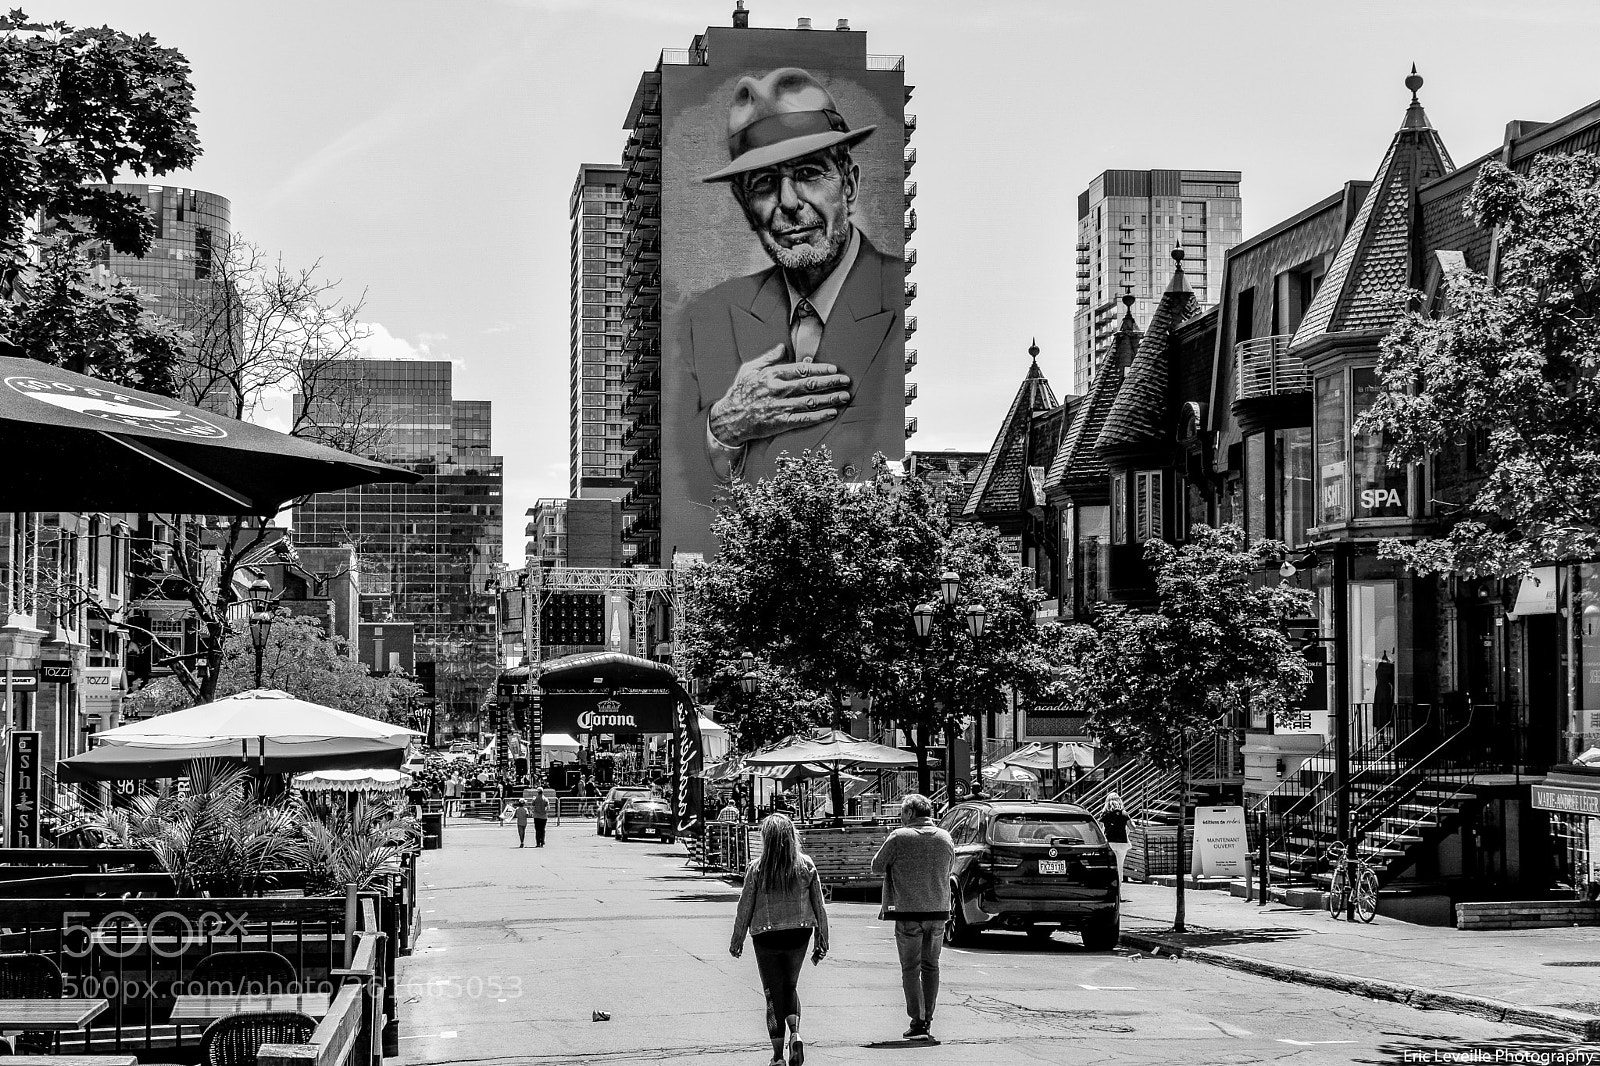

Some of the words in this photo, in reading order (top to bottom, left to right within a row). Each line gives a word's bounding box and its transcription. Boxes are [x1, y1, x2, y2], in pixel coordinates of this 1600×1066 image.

[1360, 488, 1402, 509] SPA
[43, 666, 72, 677] TOZZI
[86, 676, 109, 685] TOZZI
[577, 710, 635, 731] Corona
